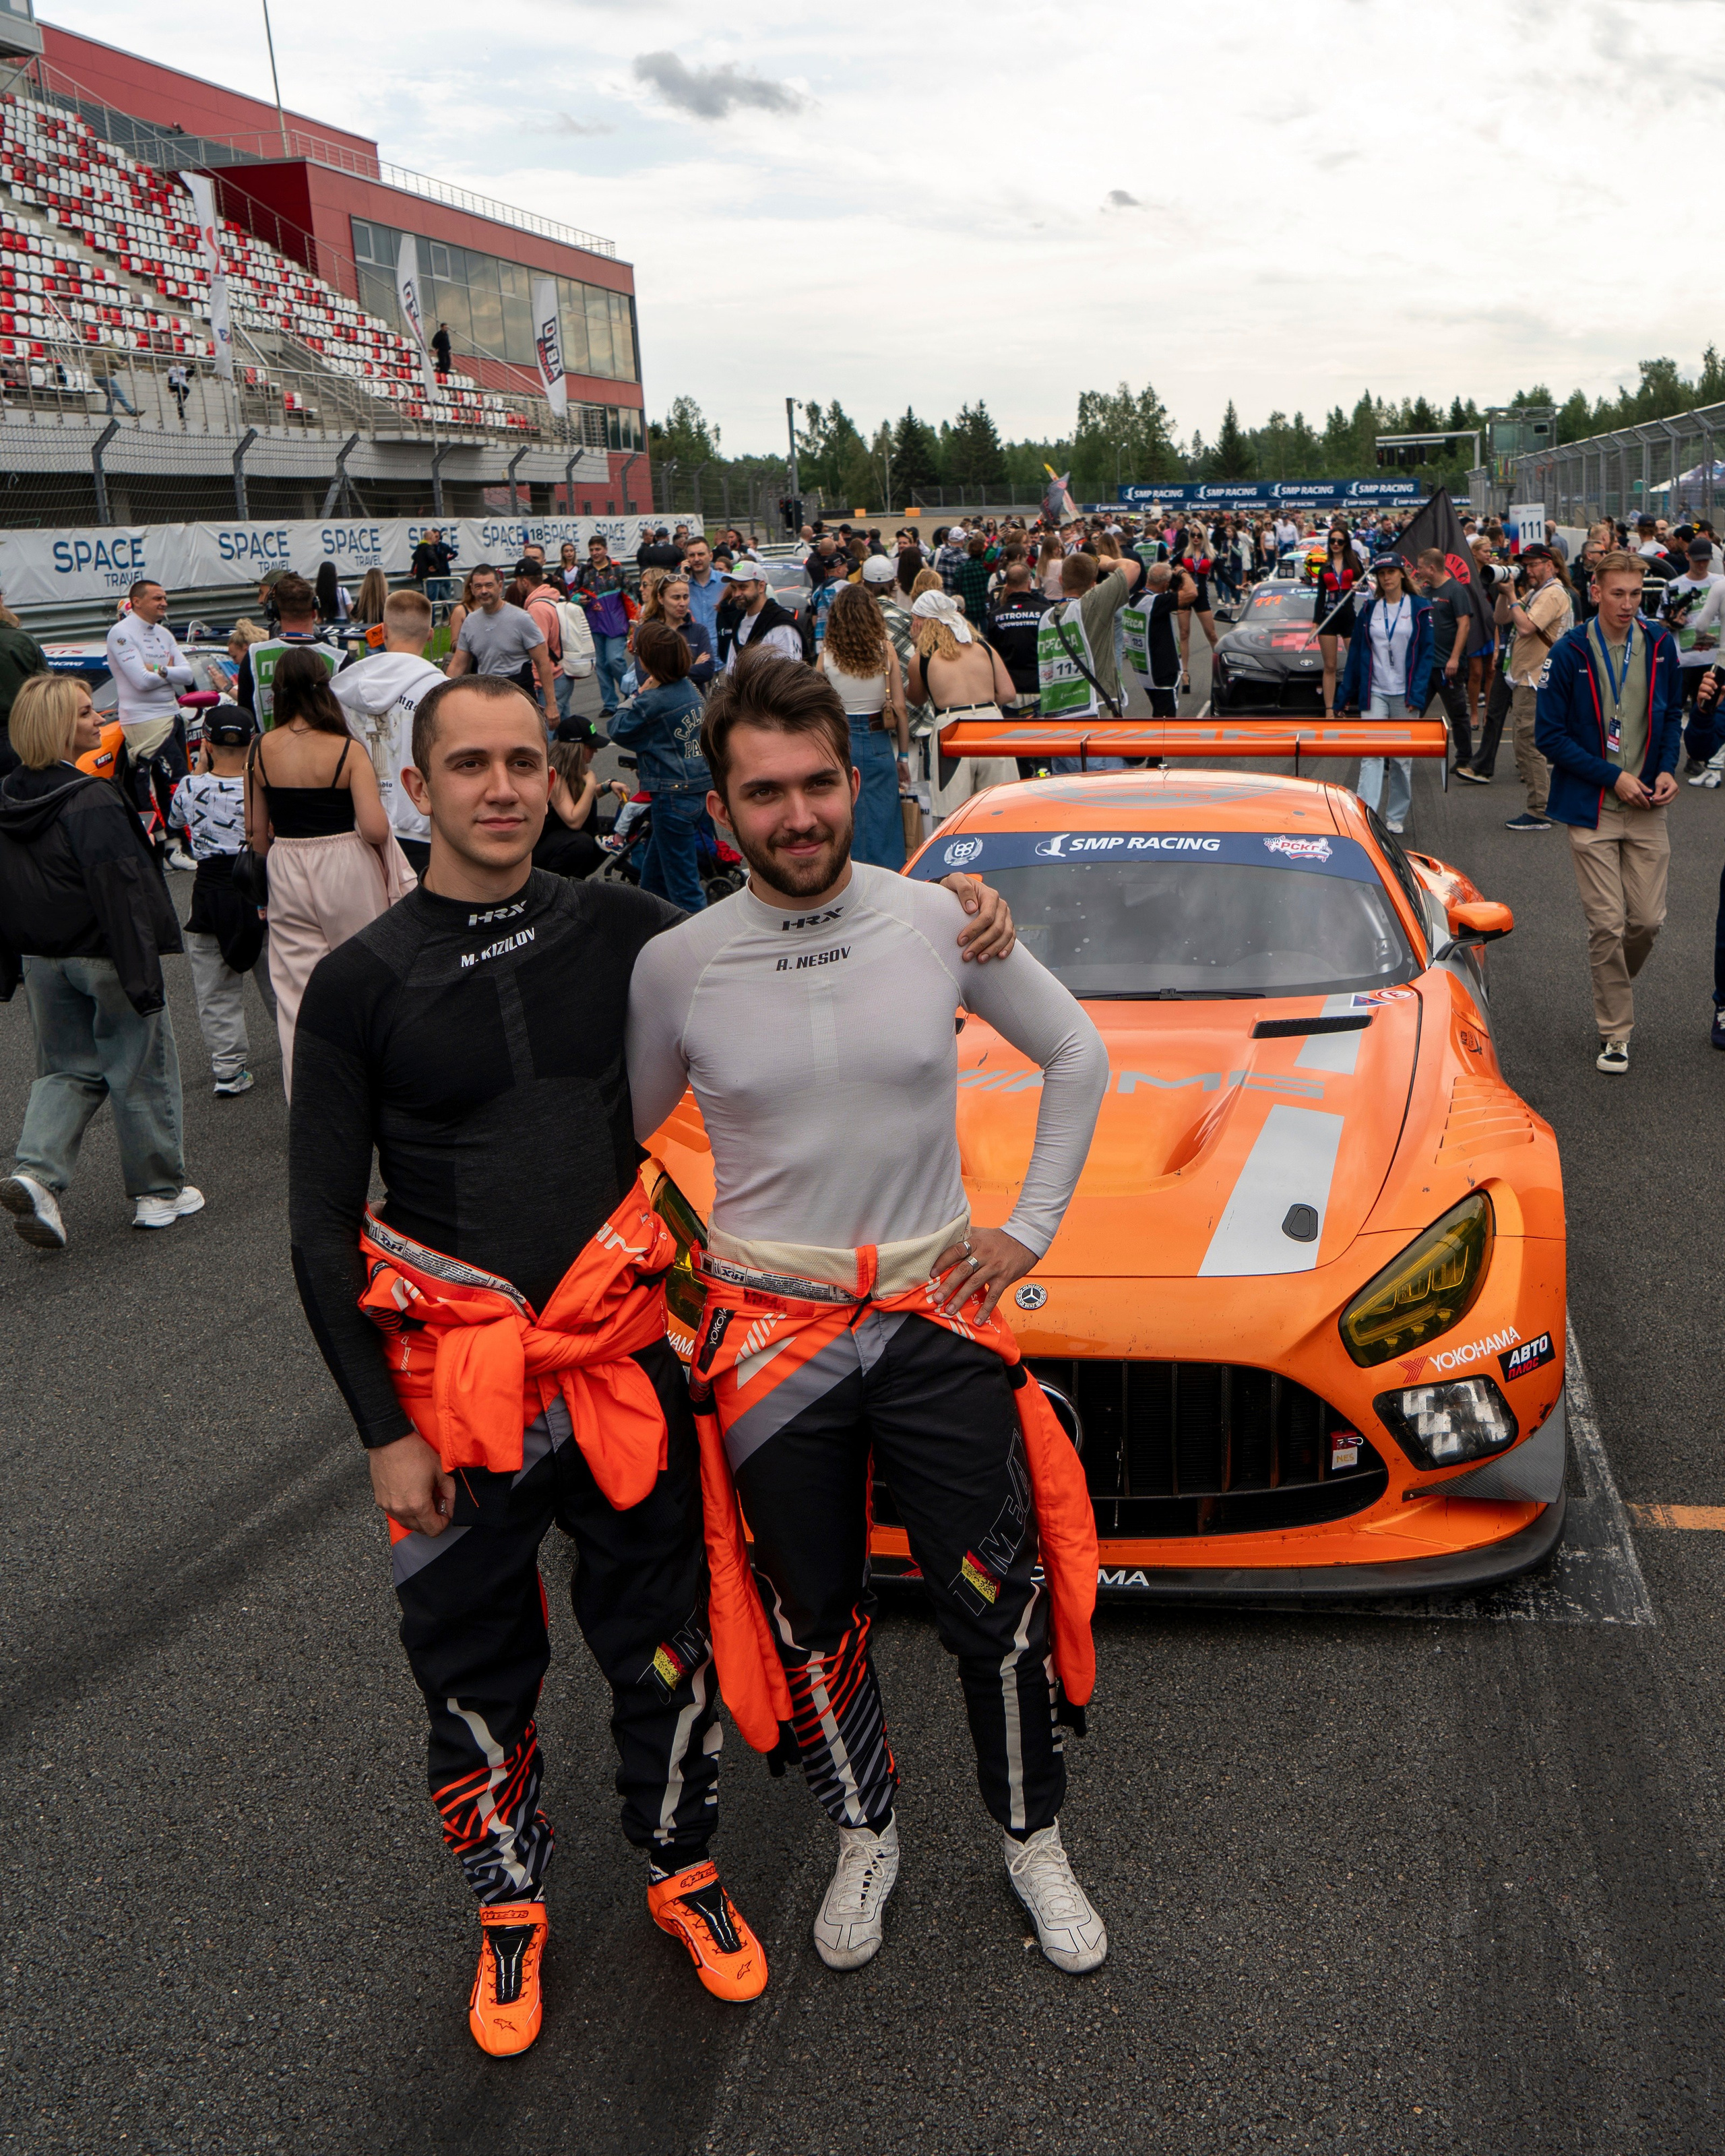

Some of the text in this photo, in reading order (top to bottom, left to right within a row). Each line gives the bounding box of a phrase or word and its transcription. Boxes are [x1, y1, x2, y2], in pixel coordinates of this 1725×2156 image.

[1134, 488, 1184, 499] SMP RACING
[1206, 487, 1257, 497] SMP RACING
[1281, 484, 1334, 495] SMP RACING
[1359, 483, 1414, 494] SMP RACING
[482, 525, 524, 548] SPACE
[529, 528, 543, 541] 18
[544, 524, 579, 544] SPACE
[1521, 521, 1541, 539] 111
[218, 531, 290, 561] SPACE
[321, 528, 381, 555] SPACE
[53, 538, 145, 573] SPACE
[354, 555, 383, 567] TRAVEL
[1254, 595, 1283, 608] 111
[995, 611, 1040, 623] PETRONAS
[1069, 836, 1221, 852] SMP RACING
[1281, 842, 1319, 851] РСКГ
[468, 900, 527, 926] HRX
[782, 906, 844, 931] HRX
[461, 927, 535, 968] M. KIZILOV
[776, 946, 851, 971] A. NESOV
[1429, 1325, 1522, 1372] YOKOHAMA
[1508, 1335, 1548, 1368] АВТО
[1508, 1356, 1540, 1380] ПЛЮС
[1336, 1453, 1355, 1463] NES
